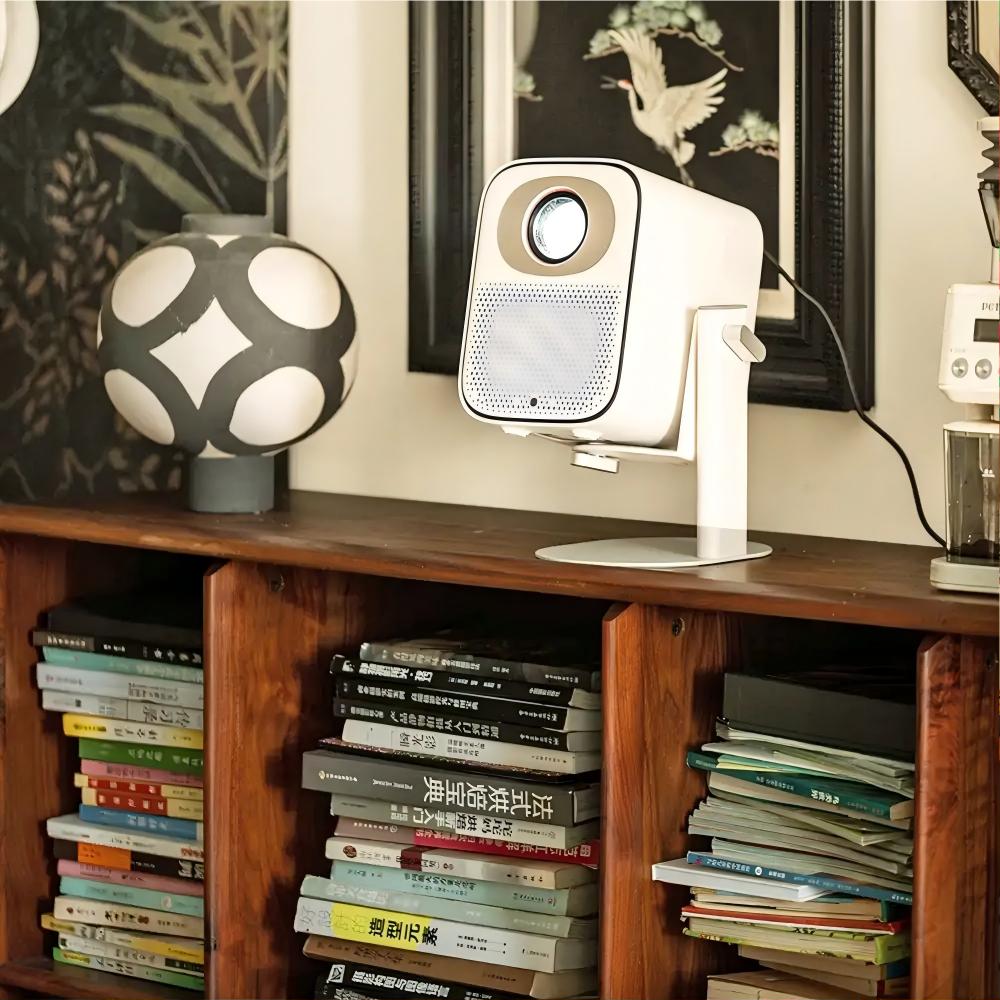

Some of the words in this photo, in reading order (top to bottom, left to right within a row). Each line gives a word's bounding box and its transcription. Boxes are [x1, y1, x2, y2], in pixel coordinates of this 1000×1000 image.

[423, 776, 554, 820] 法式烘焙宝典
[368, 917, 439, 947] 造型元素
